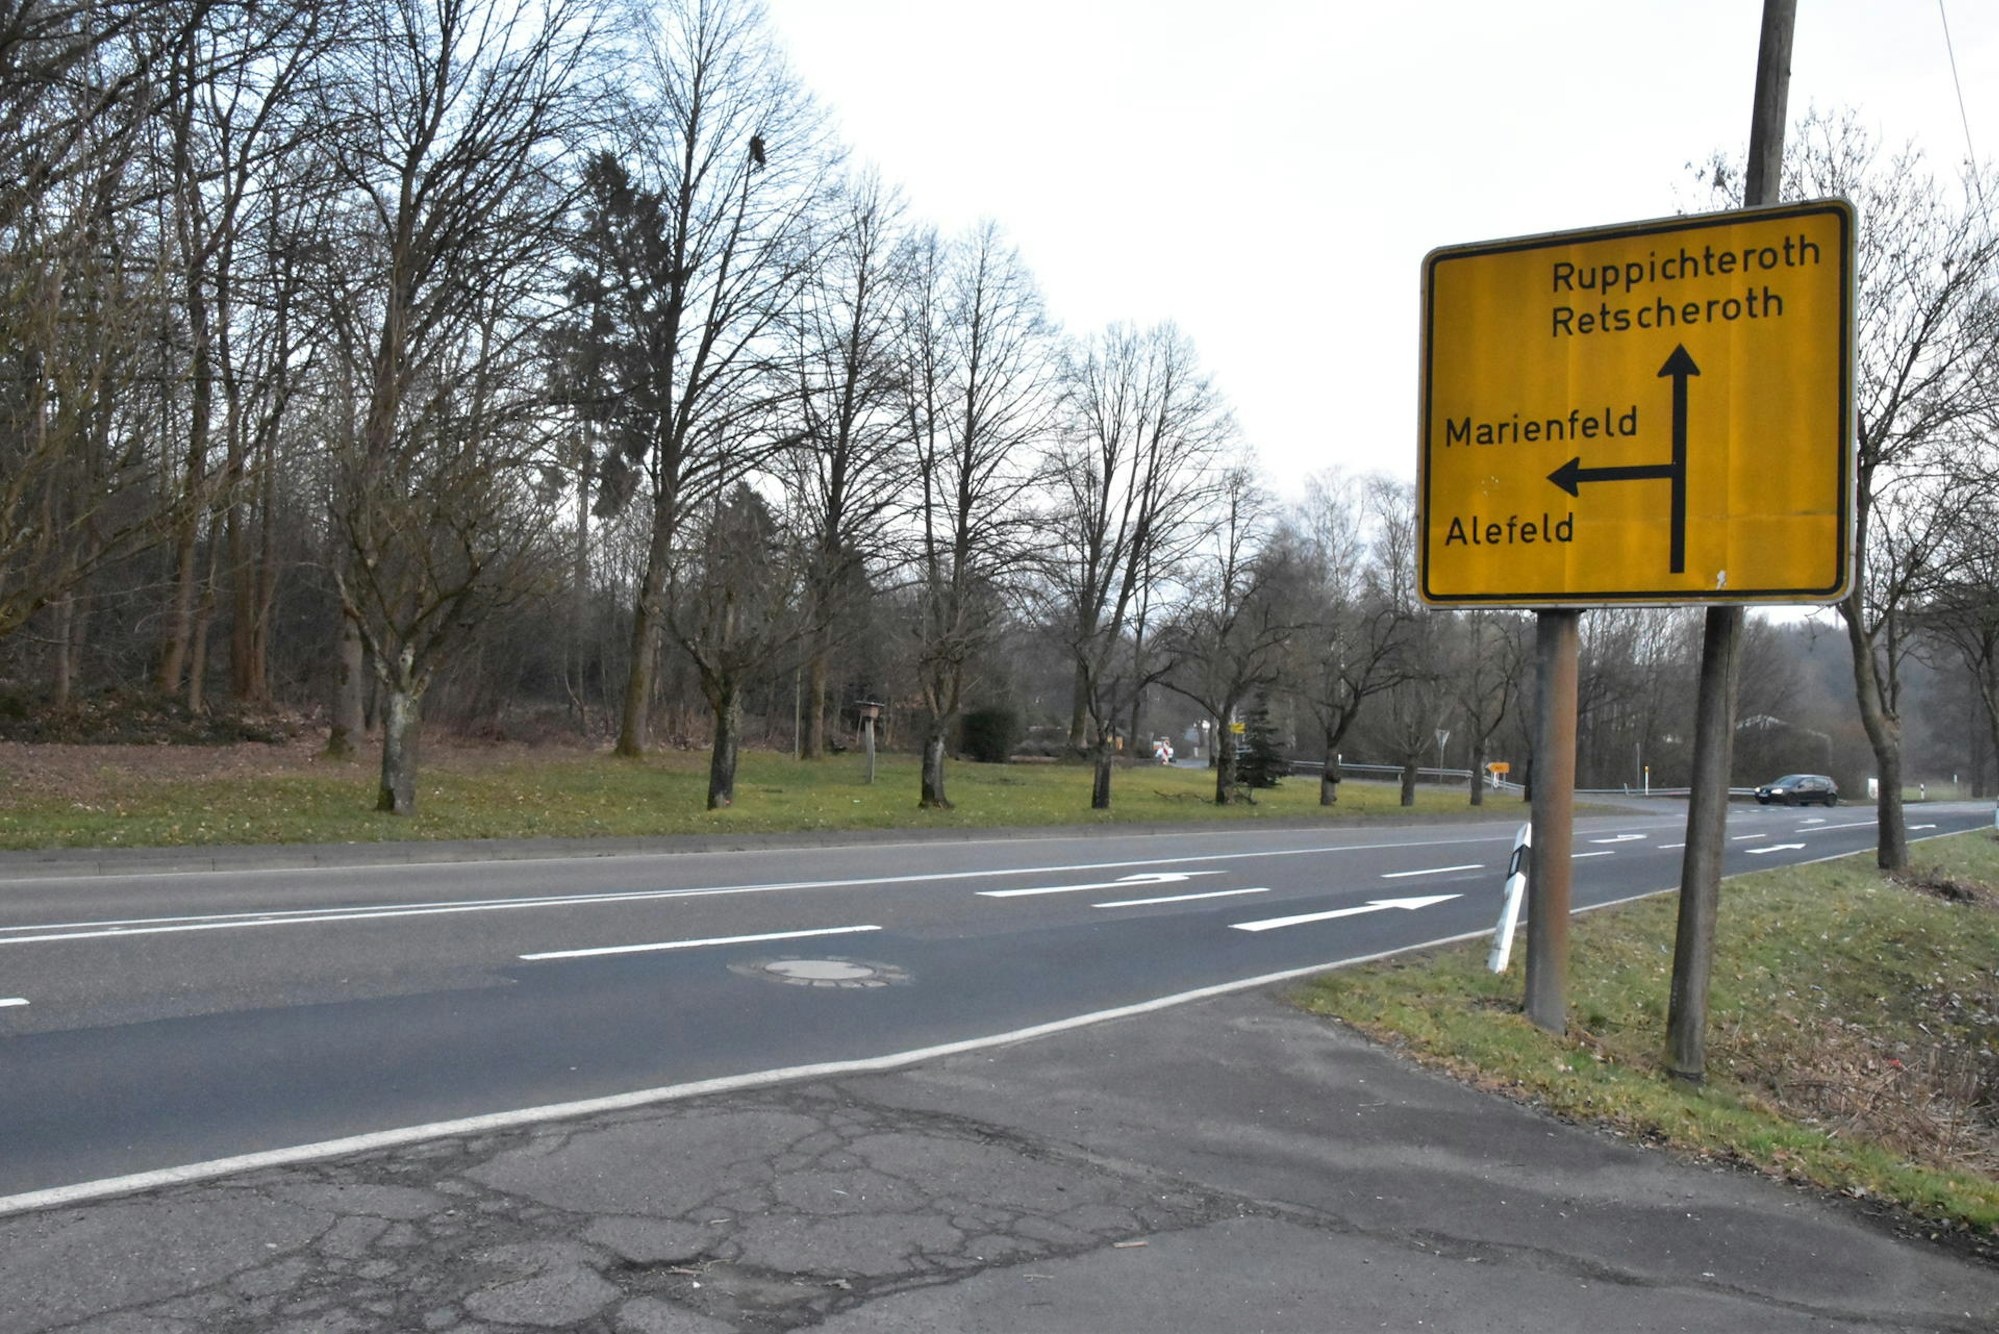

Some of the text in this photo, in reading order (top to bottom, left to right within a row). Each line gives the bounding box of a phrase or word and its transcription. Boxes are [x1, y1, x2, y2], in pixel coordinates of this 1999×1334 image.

[1553, 234, 1821, 295] Ruppichteroth
[1552, 286, 1784, 338] Retscheroth
[1445, 405, 1638, 448] Marienfeld
[1444, 512, 1574, 546] Alefeld
